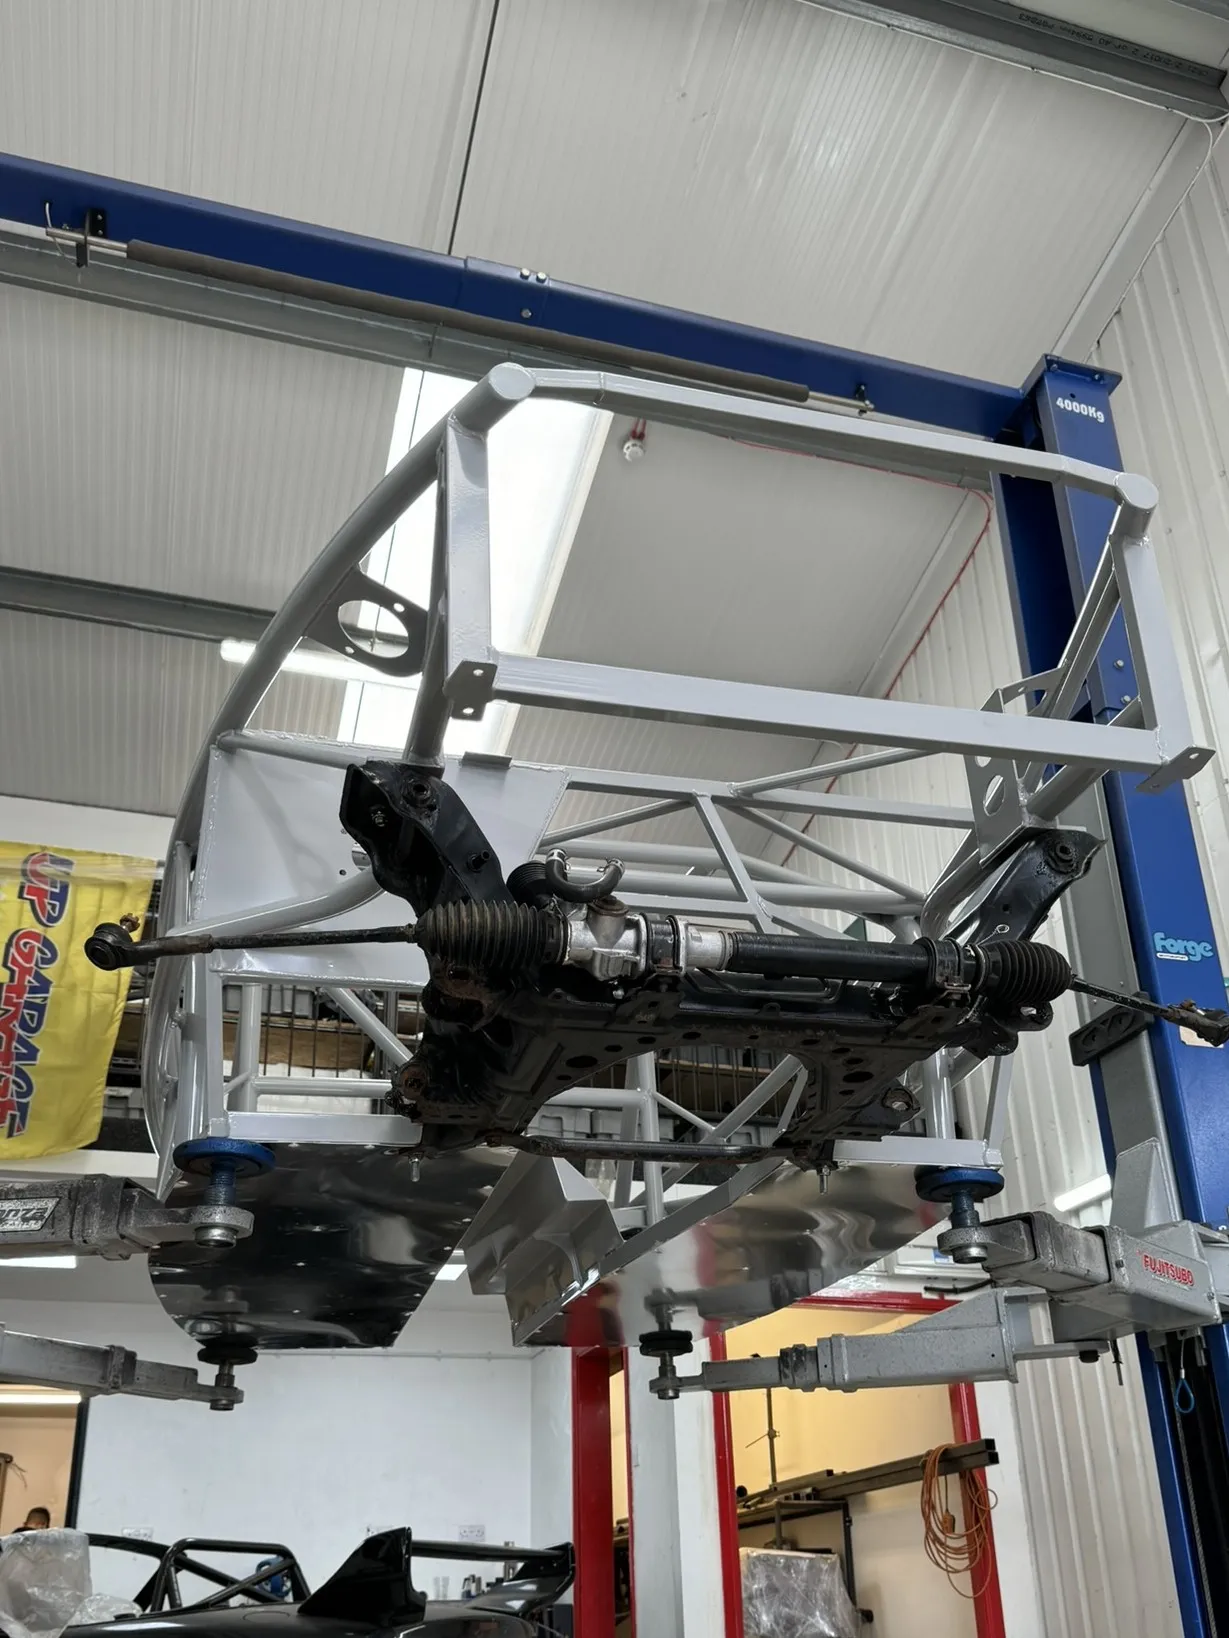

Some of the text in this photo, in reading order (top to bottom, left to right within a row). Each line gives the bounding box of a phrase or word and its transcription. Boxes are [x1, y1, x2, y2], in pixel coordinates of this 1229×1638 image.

[1056, 396, 1105, 423] 4000Kg
[0, 851, 76, 1139] UP GARAGE
[1143, 1254, 1194, 1286] FUJITSUBO
